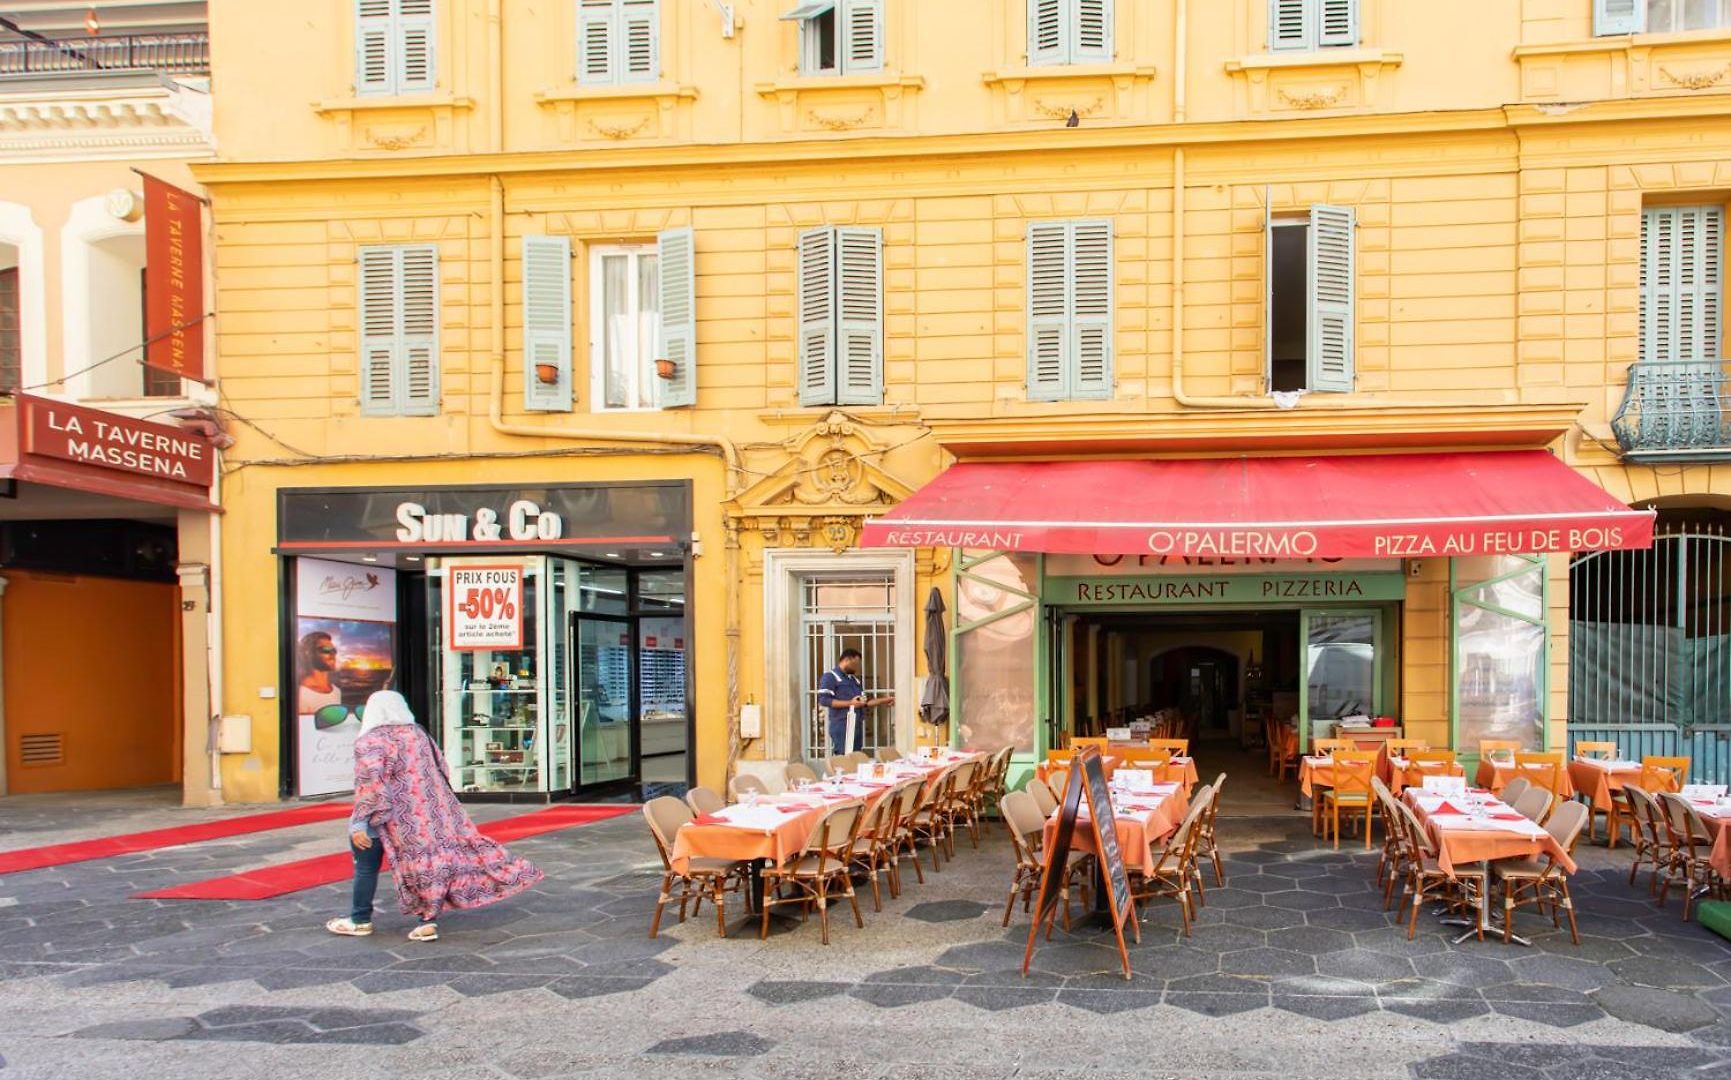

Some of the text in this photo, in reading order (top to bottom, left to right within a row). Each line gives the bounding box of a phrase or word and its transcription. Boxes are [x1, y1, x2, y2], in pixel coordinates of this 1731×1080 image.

[167, 191, 185, 370] LA TAVERNE MASSENA
[48, 411, 202, 460] LA TAVERNE
[67, 438, 186, 478] MASSENA
[473, 507, 501, 541] &
[886, 530, 1023, 548] RESTAURANT
[1148, 531, 1317, 555] O'PALERMO
[1374, 527, 1624, 555] PIZZA AU FEU DE BOIS
[456, 571, 516, 584] PRIX FOUS
[1263, 579, 1362, 597] PIZZERIA
[458, 587, 515, 620] -50%
